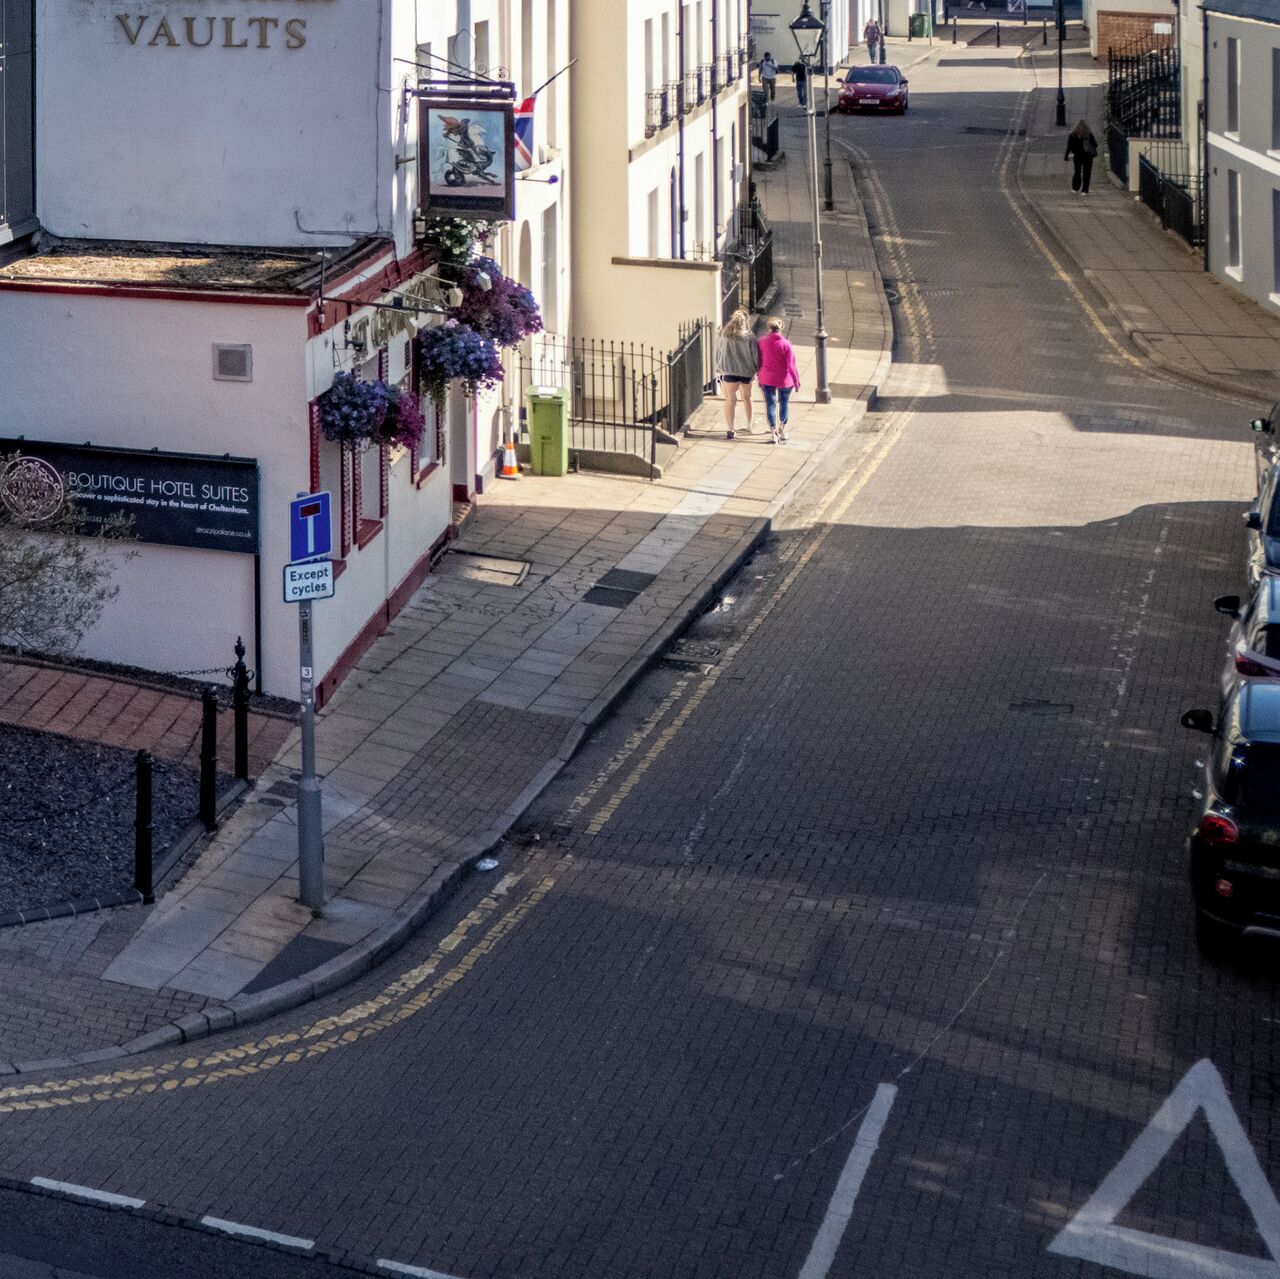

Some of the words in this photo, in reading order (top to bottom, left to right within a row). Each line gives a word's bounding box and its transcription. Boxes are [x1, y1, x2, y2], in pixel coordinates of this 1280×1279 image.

[116, 13, 307, 48] VAULTS
[69, 472, 144, 493] BOUTIQUE
[151, 480, 195, 499] HOTEL
[201, 484, 249, 503] SUITES
[104, 494, 144, 504] sophisticated
[146, 499, 159, 507] stay
[181, 501, 199, 509] heart
[290, 567, 329, 581] Except
[292, 582, 327, 596] cycles
